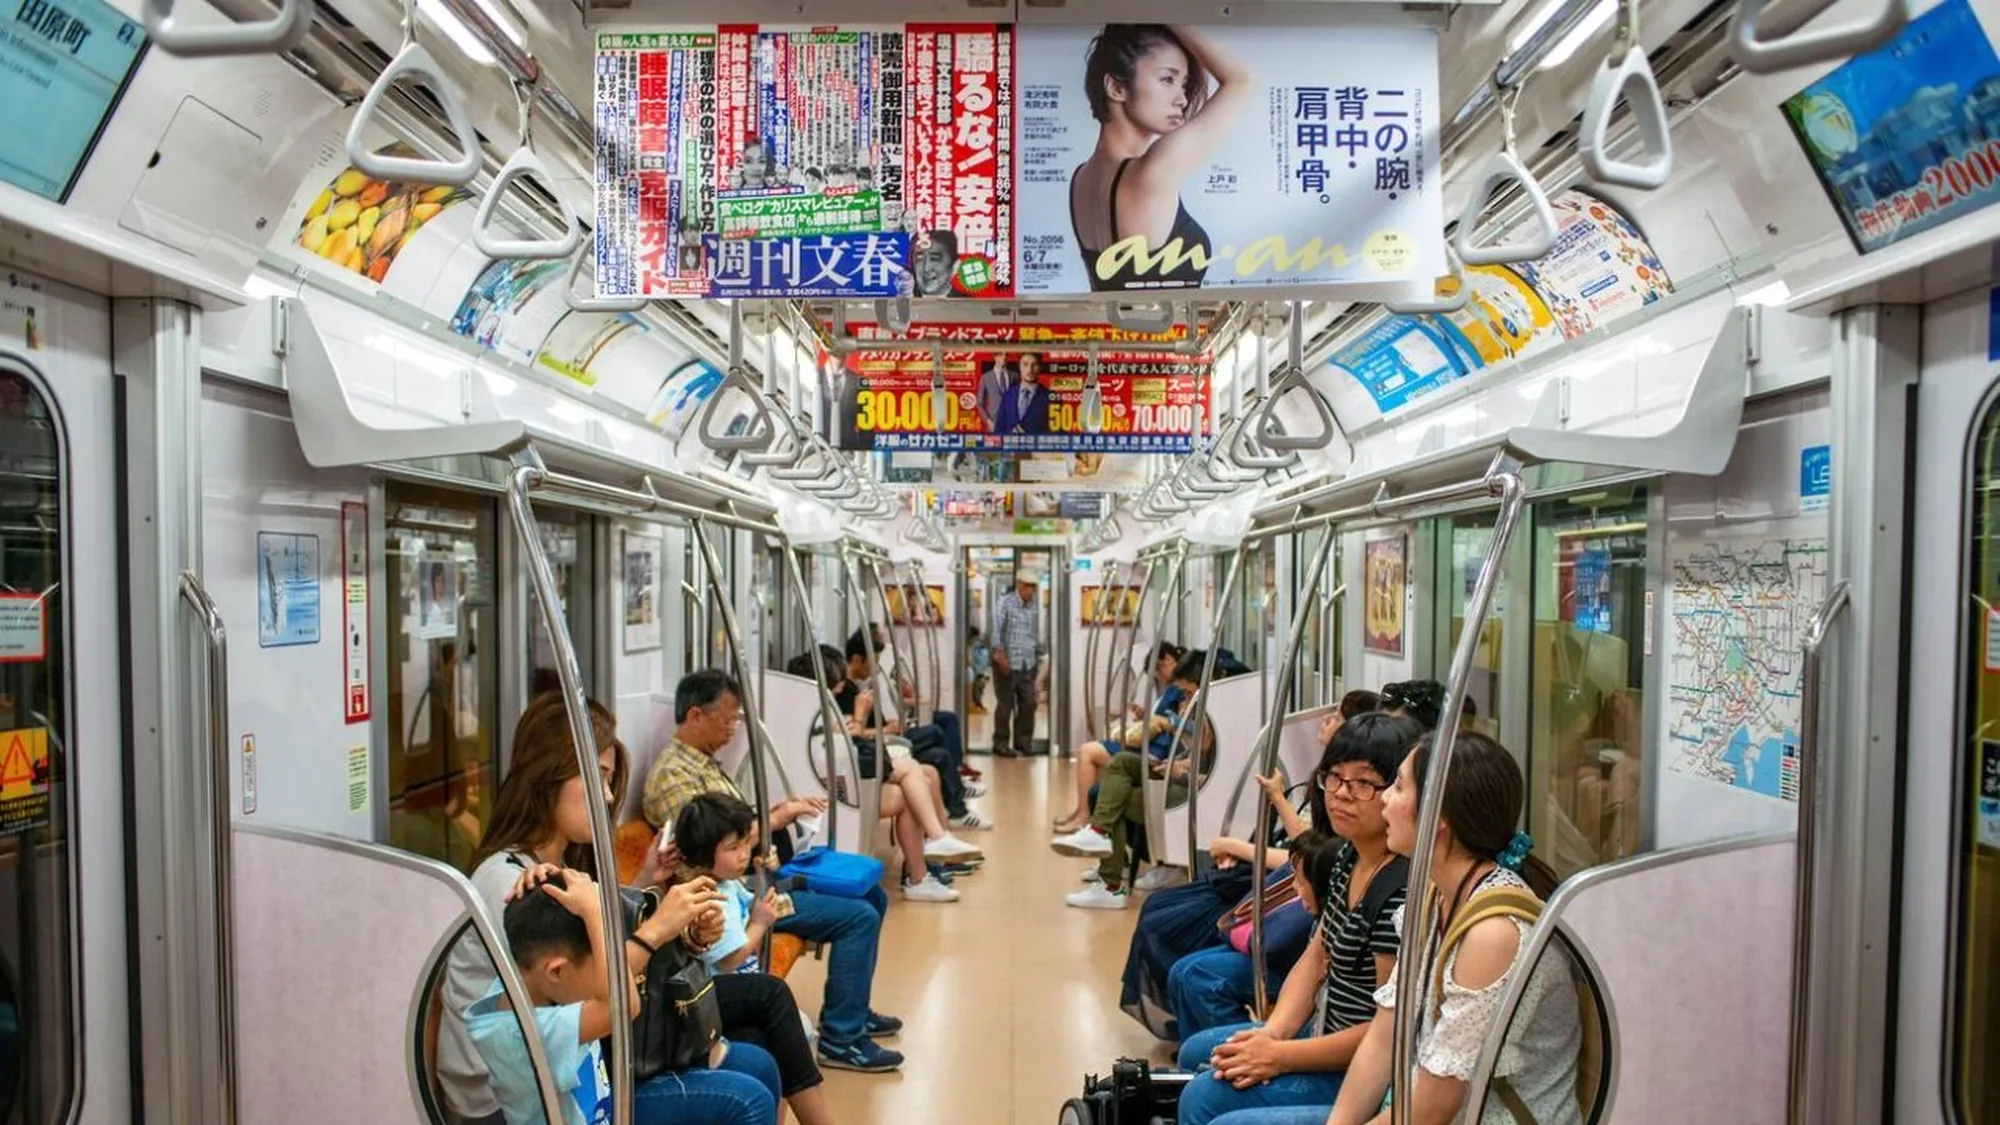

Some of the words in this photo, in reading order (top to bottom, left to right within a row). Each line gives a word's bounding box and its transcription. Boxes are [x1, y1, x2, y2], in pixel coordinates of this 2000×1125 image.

[641, 53, 667, 151] 睡眠障害
[700, 51, 715, 232] 理想の枕の選び方・作り方
[1294, 87, 1330, 204] 肩甲骨。
[640, 171, 667, 294] 克服ガイド
[706, 235, 903, 287] 週刊文春
[1023, 250, 1046, 263] 6/7
